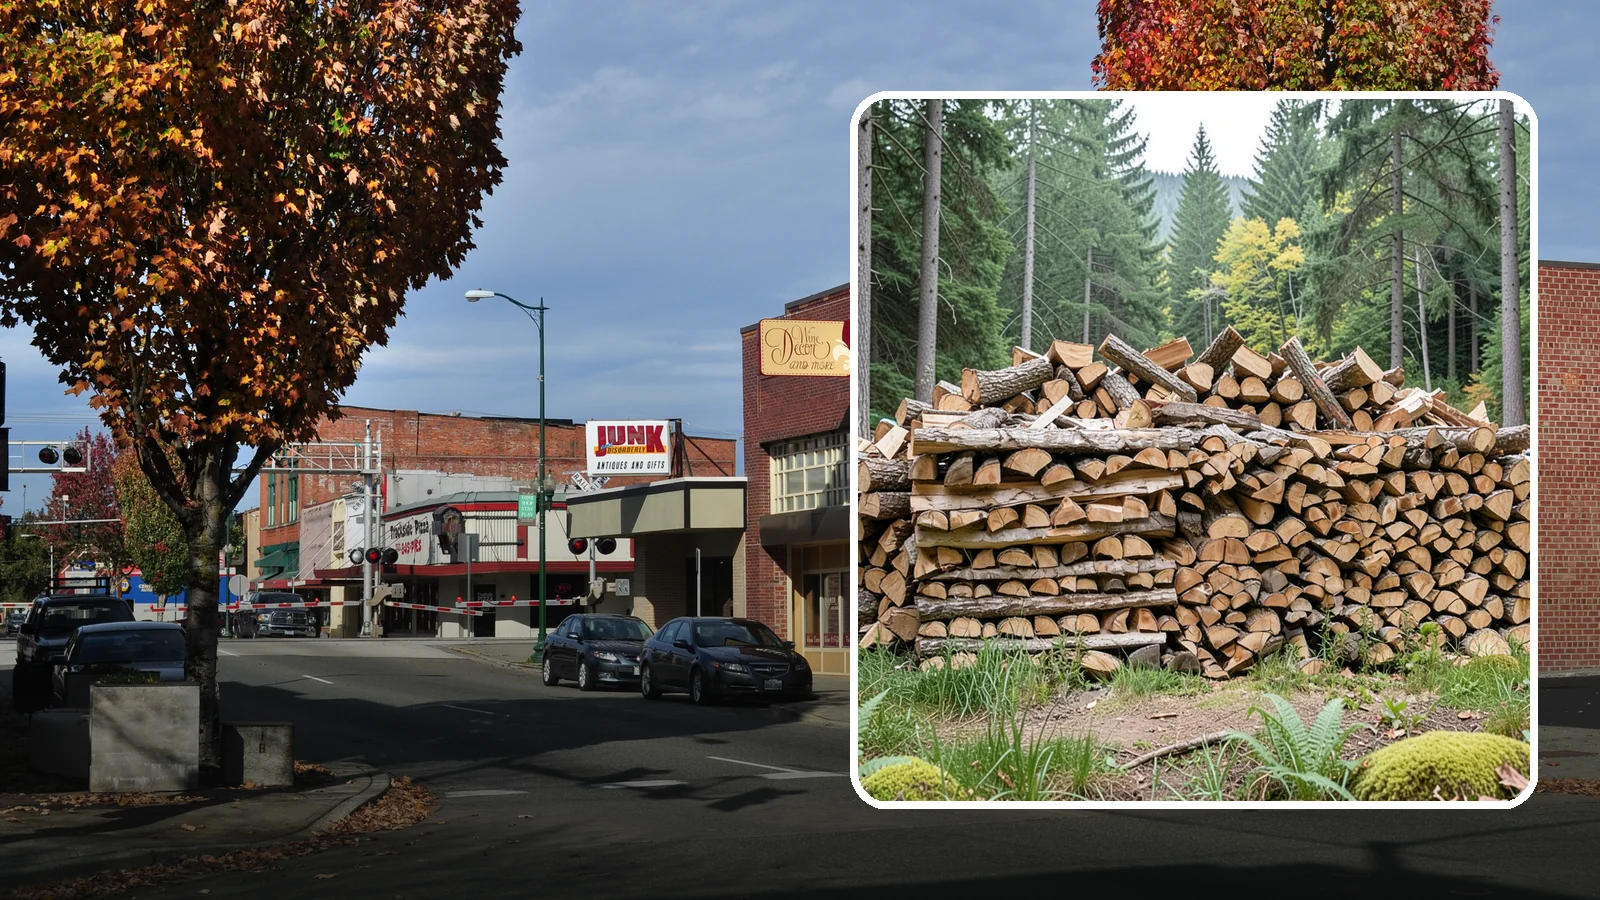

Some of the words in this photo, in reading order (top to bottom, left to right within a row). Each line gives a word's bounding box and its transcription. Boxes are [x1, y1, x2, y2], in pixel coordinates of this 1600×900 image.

[595, 425, 665, 457] JUNK
[607, 445, 646, 454] DISORDERLY
[597, 461, 628, 470] ANTIQUES
[631, 460, 644, 470] AND
[647, 460, 665, 470] GIFTS
[390, 521, 413, 539] Trackside
[414, 519, 429, 535] Pizza
